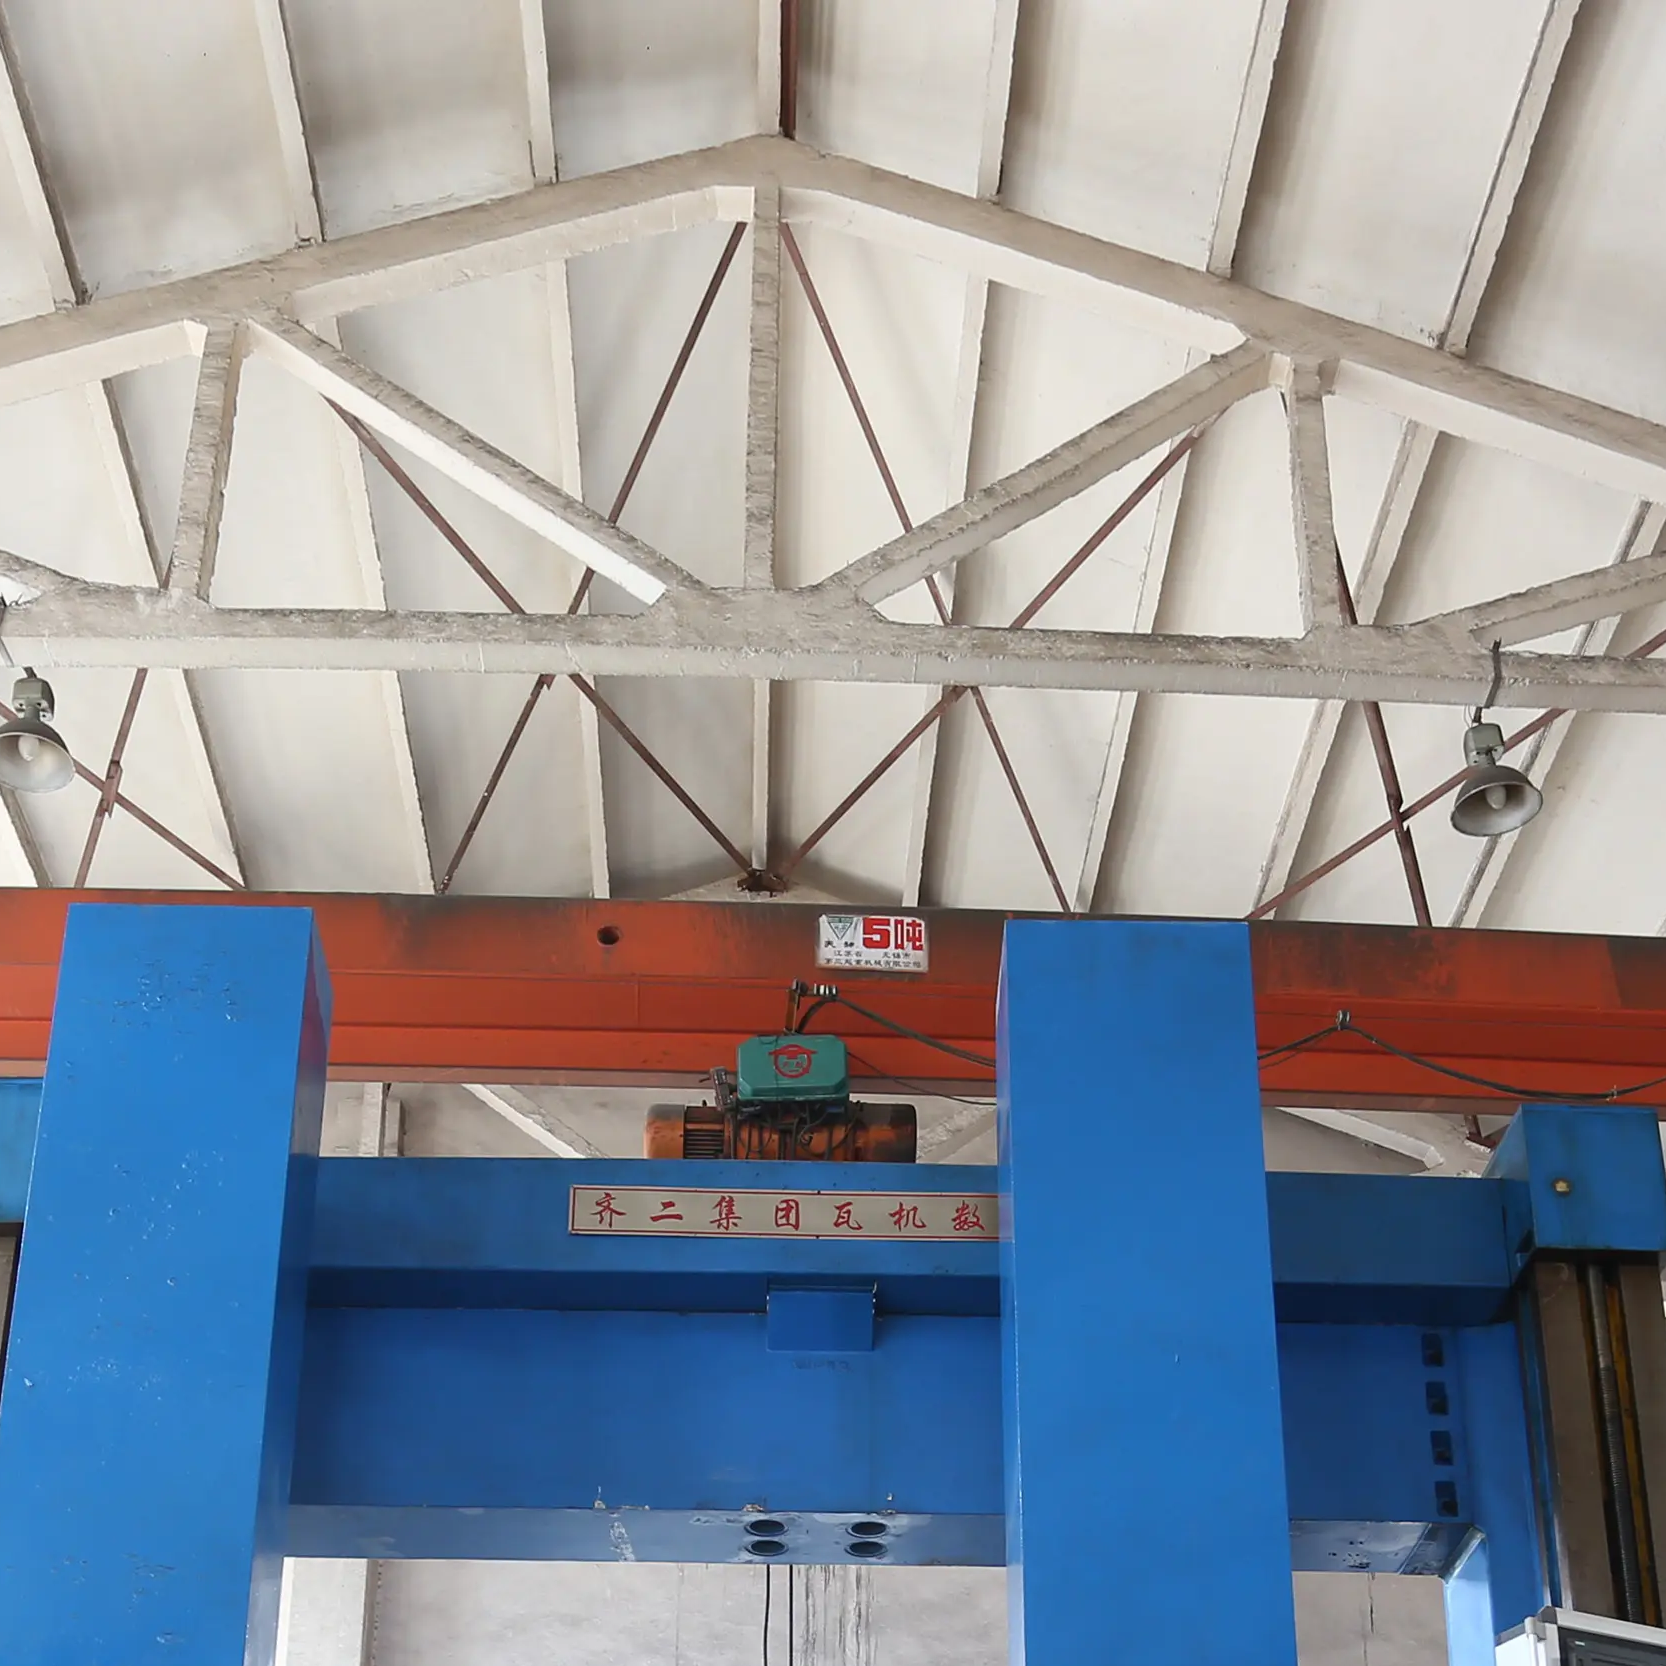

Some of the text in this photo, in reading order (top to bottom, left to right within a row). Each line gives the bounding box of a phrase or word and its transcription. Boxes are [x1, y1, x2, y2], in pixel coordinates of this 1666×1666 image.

[862, 917, 924, 951] 5吨
[590, 1192, 986, 1232] 齐二集团瓦机数
